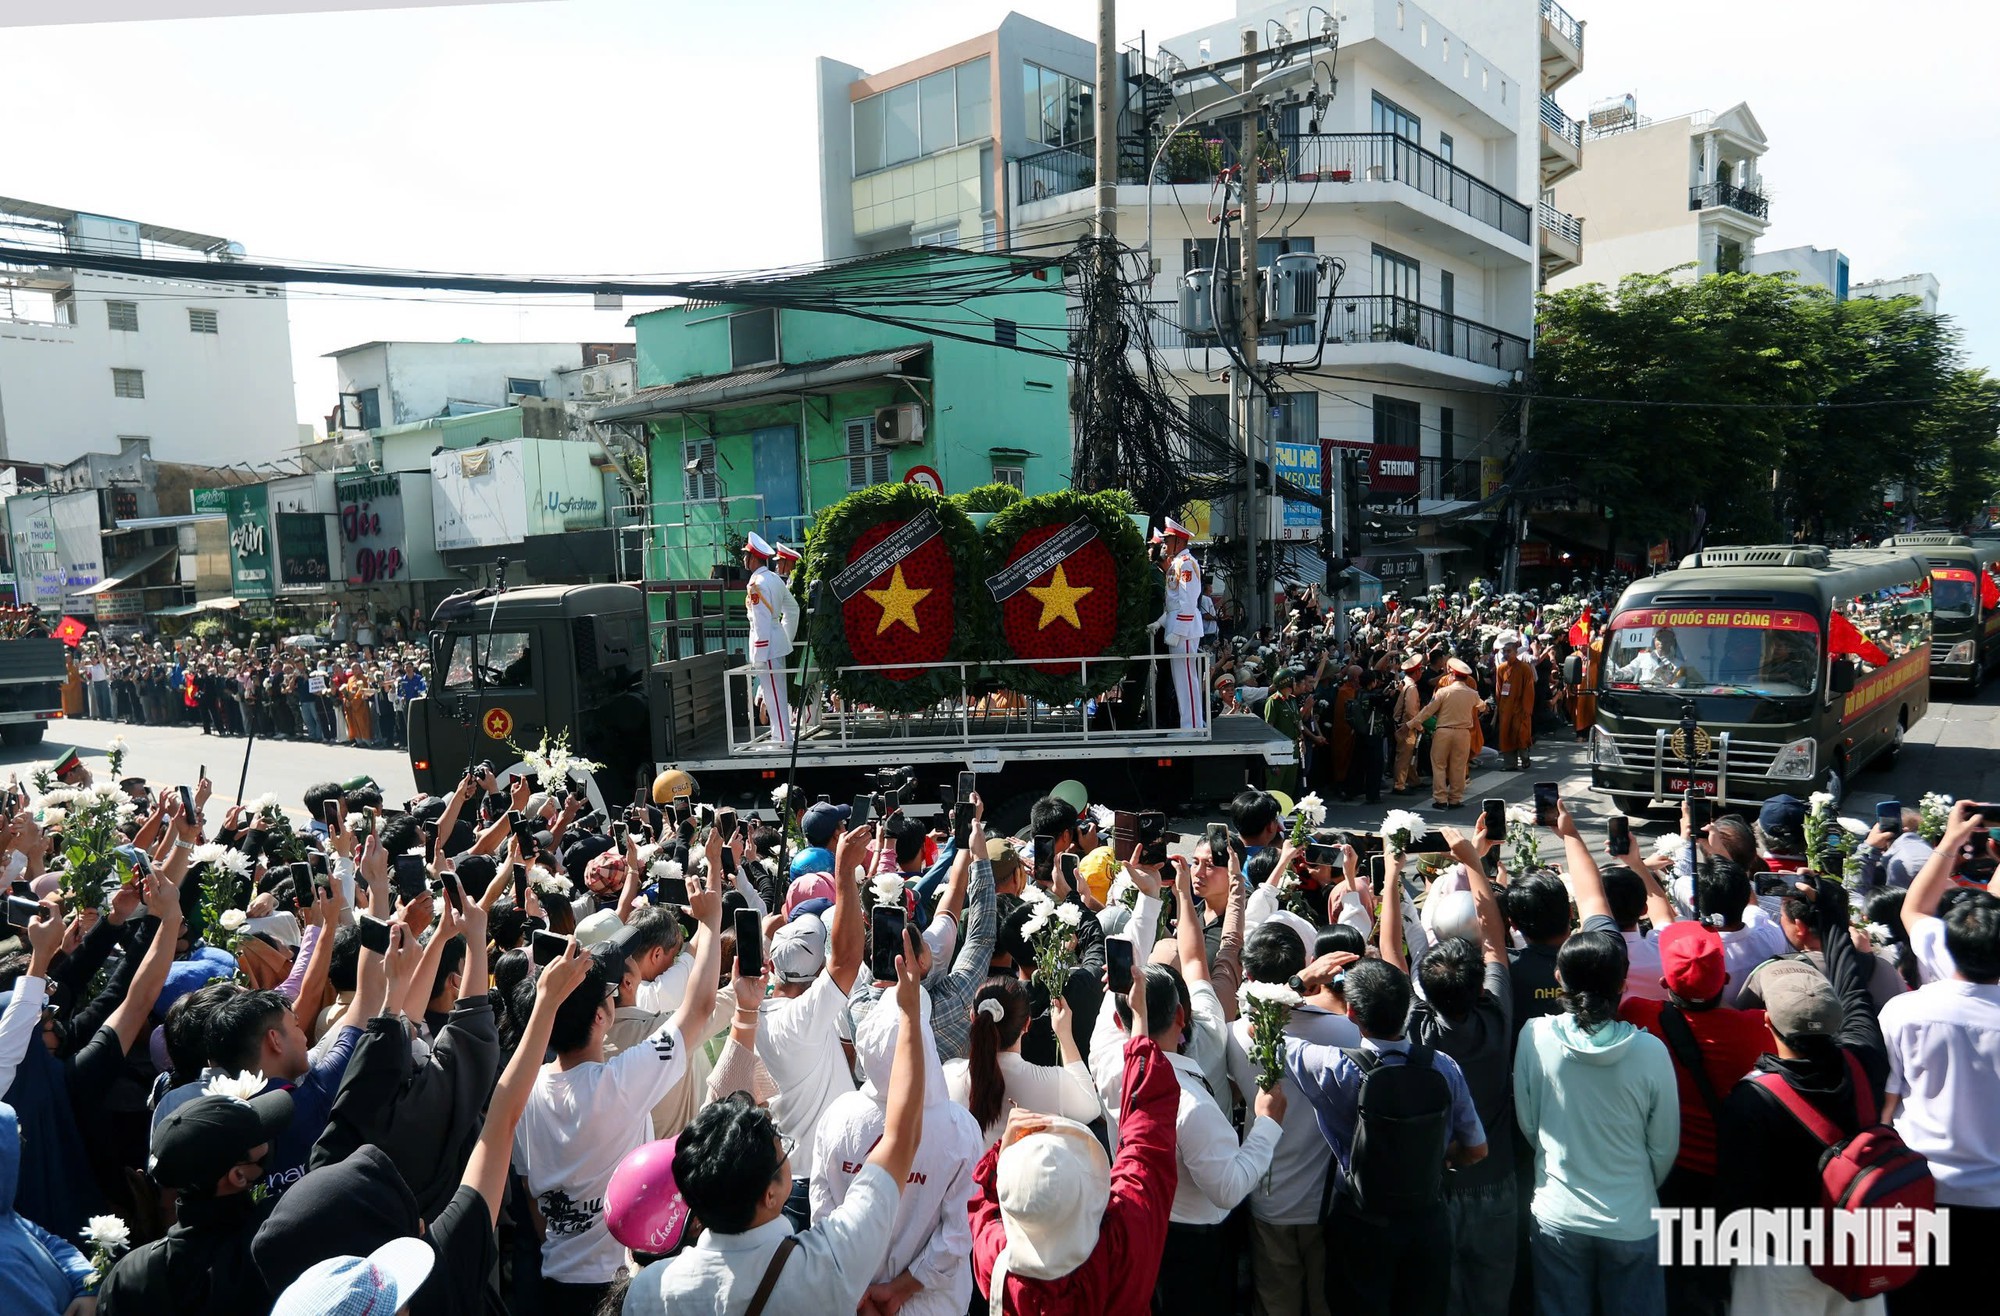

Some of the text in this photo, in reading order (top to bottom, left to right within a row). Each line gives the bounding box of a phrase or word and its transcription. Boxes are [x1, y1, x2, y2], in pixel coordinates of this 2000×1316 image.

[1379, 460, 1415, 476] STATION
[1308, 473, 1321, 488] XE
[869, 544, 911, 577] KÍNH VIẾNG
[1024, 564, 1045, 581] KÍNH
[1043, 549, 1067, 568] VIẾNG
[1651, 610, 1770, 626] TỔ QUỐC GHI CÔNG
[1629, 632, 1643, 643] 01
[650, 1208, 681, 1247] Choose
